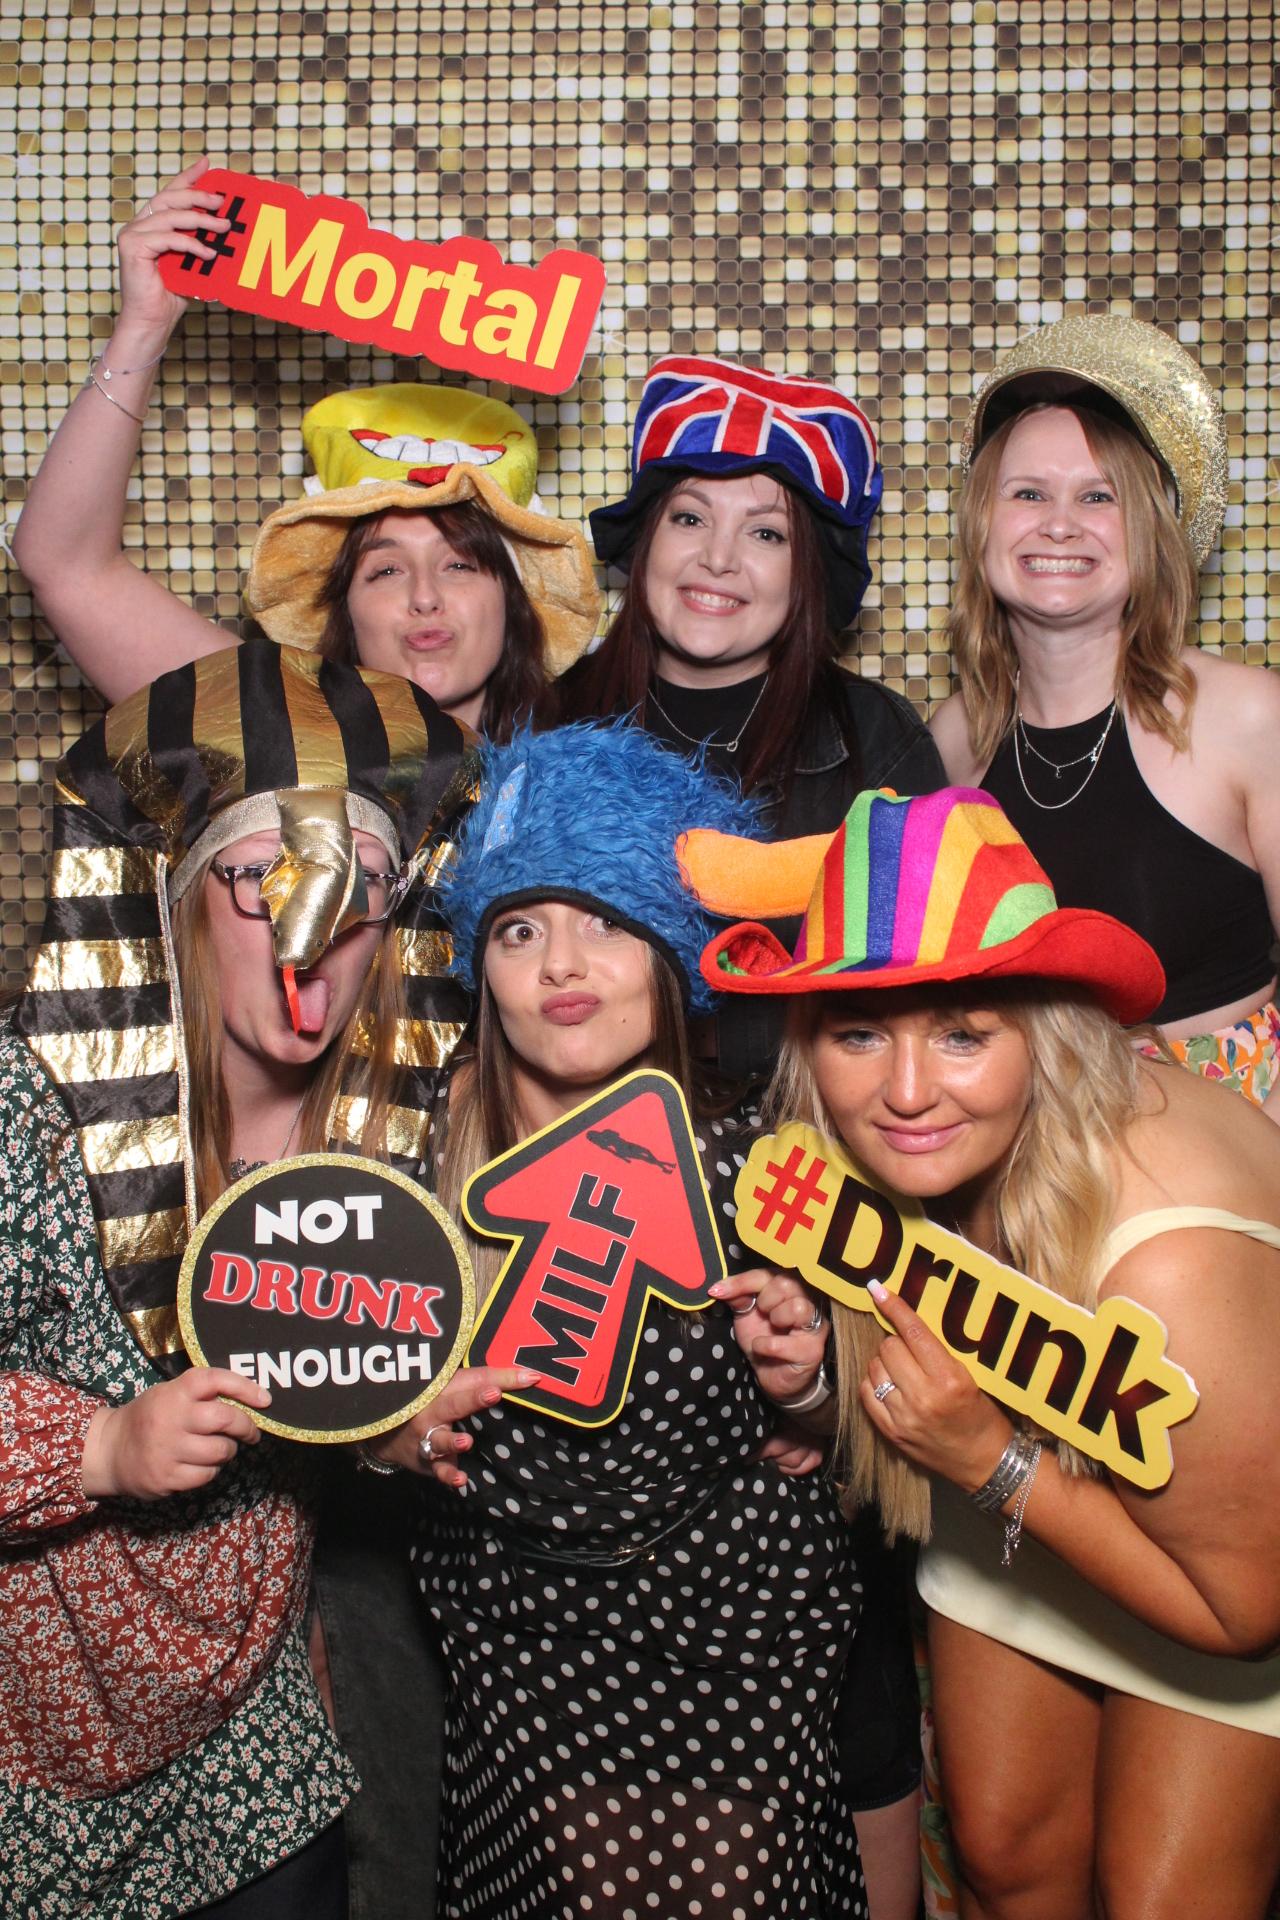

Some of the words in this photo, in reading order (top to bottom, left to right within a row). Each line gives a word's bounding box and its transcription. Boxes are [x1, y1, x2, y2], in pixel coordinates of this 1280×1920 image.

[180, 191, 582, 370] #Mortal
[254, 1195, 383, 1245] NOT
[513, 1172, 637, 1387] MILF
[203, 1252, 443, 1337] DRUNK
[752, 1144, 1171, 1465] #Drunk
[229, 1342, 432, 1389] ENOUGH
